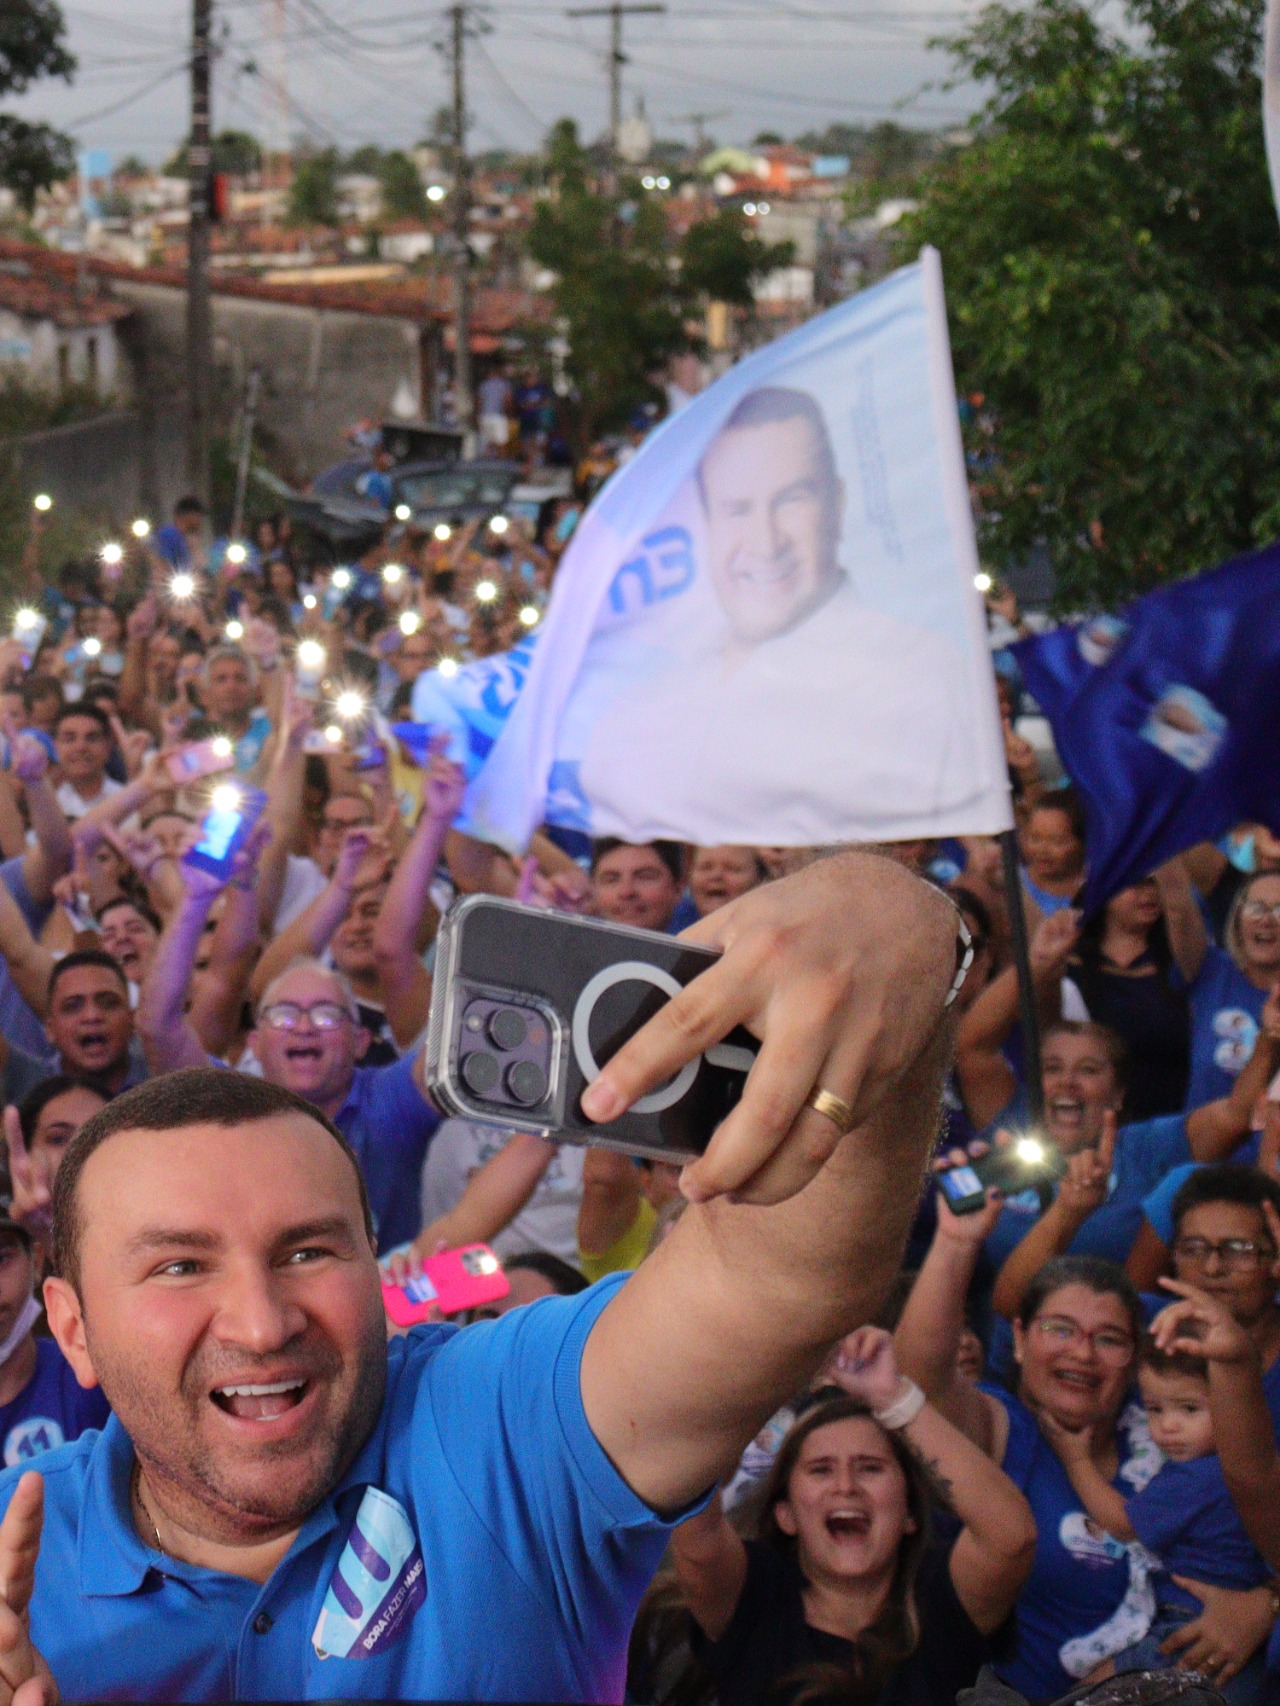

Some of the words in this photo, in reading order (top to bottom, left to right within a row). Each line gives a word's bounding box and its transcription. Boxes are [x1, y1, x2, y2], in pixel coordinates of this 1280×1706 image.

[363, 1618, 388, 1650] BORA
[382, 1586, 407, 1622] FAZER
[404, 1558, 423, 1589] MAIS
